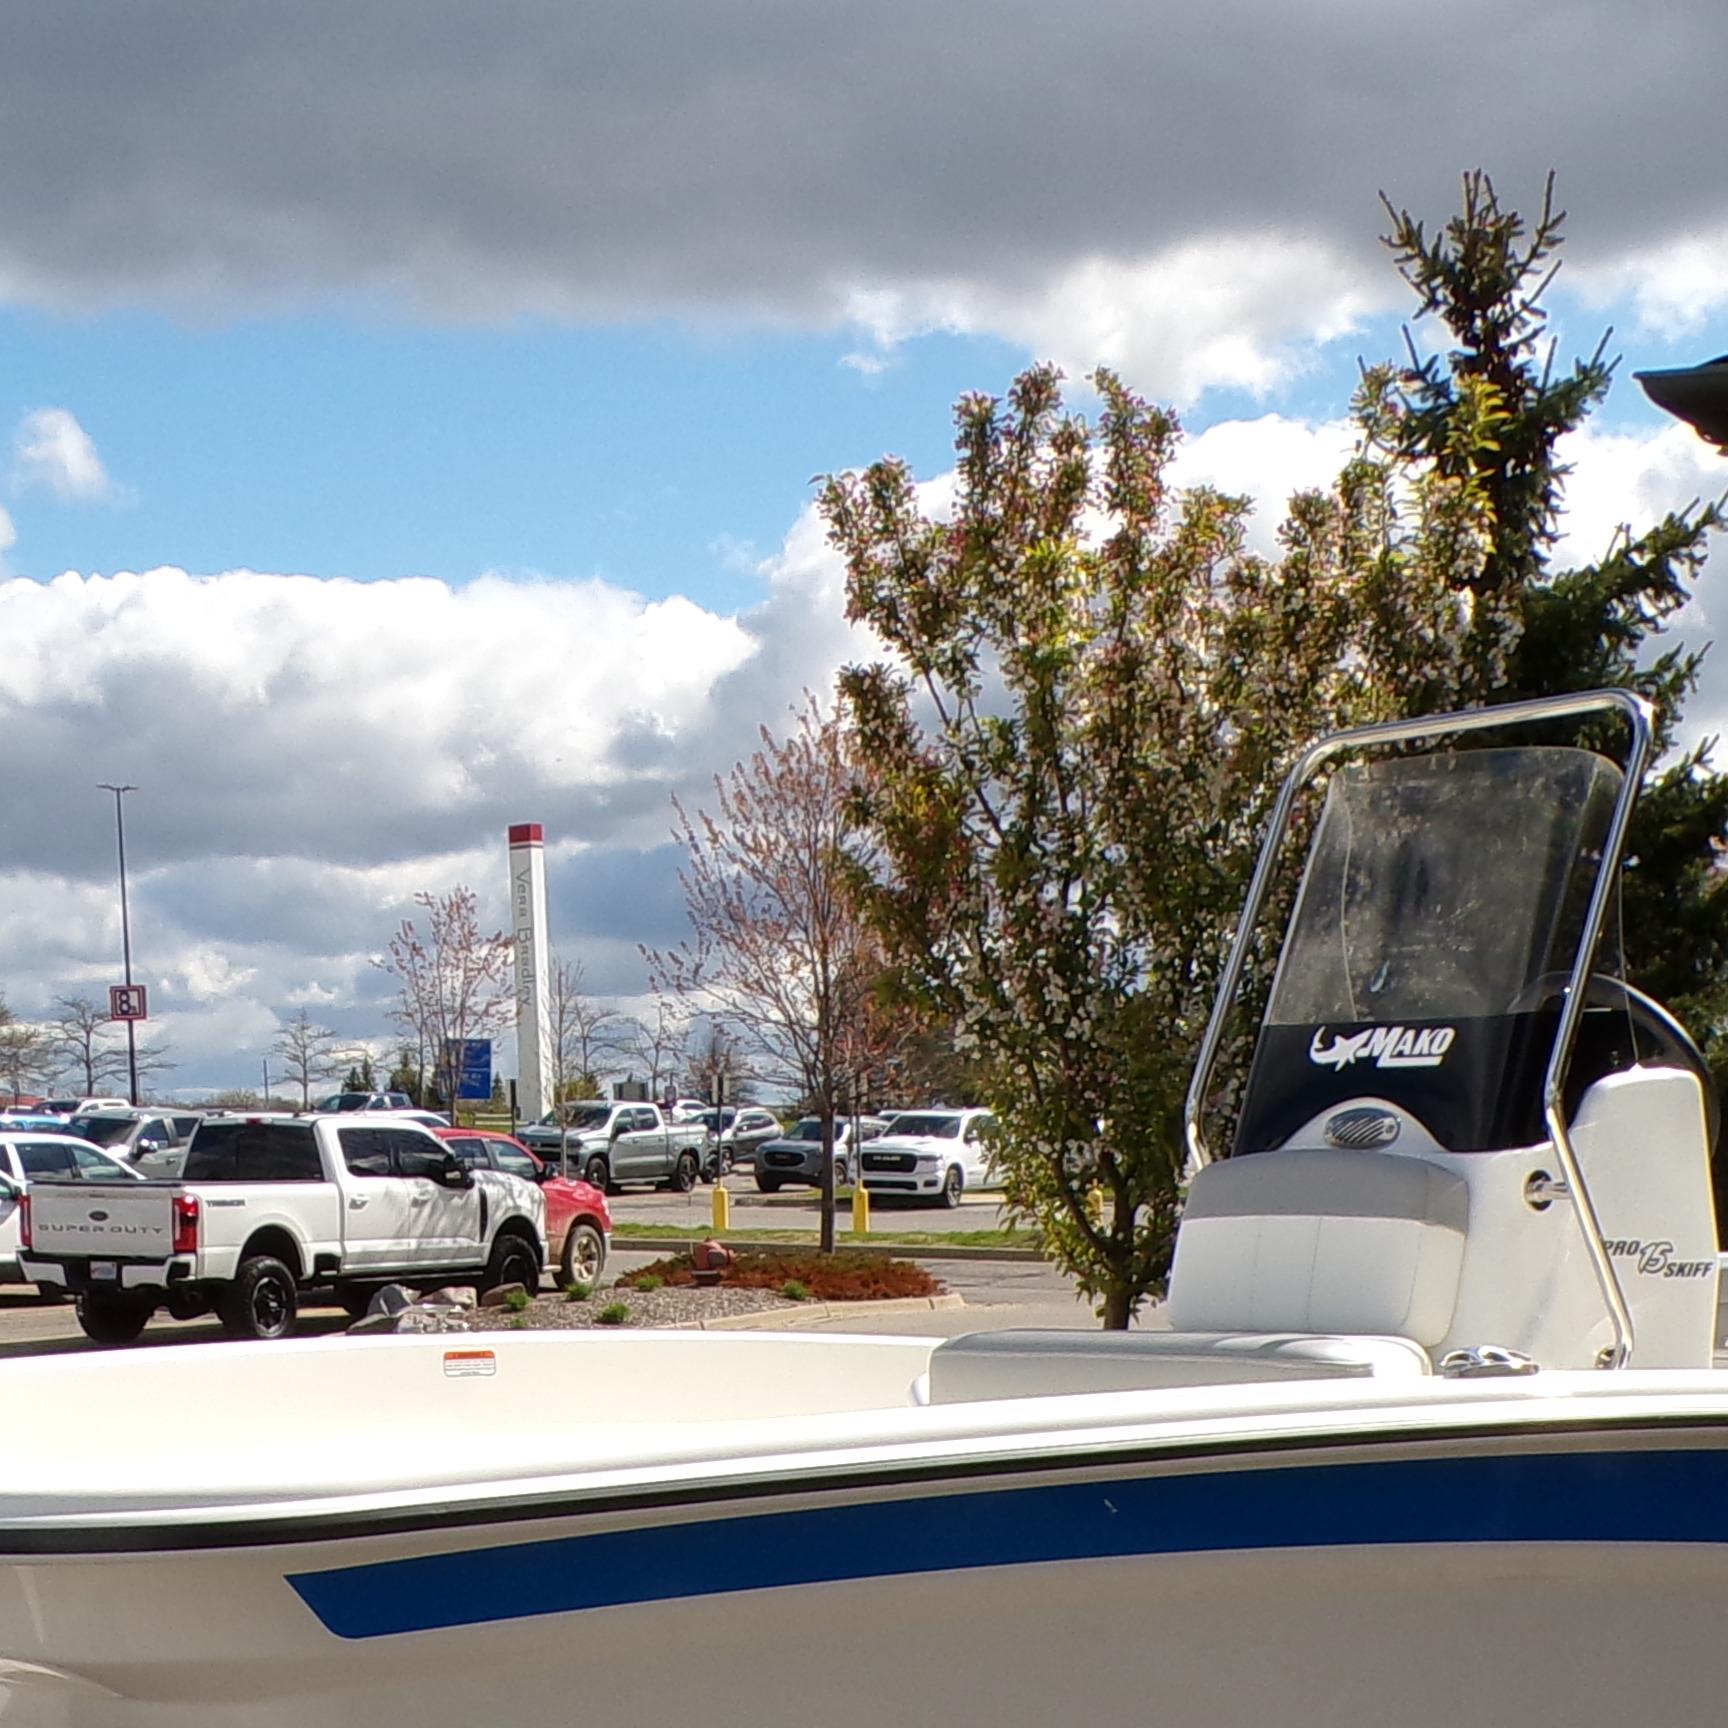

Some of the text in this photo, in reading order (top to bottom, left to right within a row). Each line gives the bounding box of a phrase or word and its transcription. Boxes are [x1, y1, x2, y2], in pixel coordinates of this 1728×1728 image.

[1354, 1026, 1456, 1068] MAKO
[38, 1223, 164, 1235] SUPER DUTY
[1601, 1240, 1714, 1278] PRO 15 SKIFF
